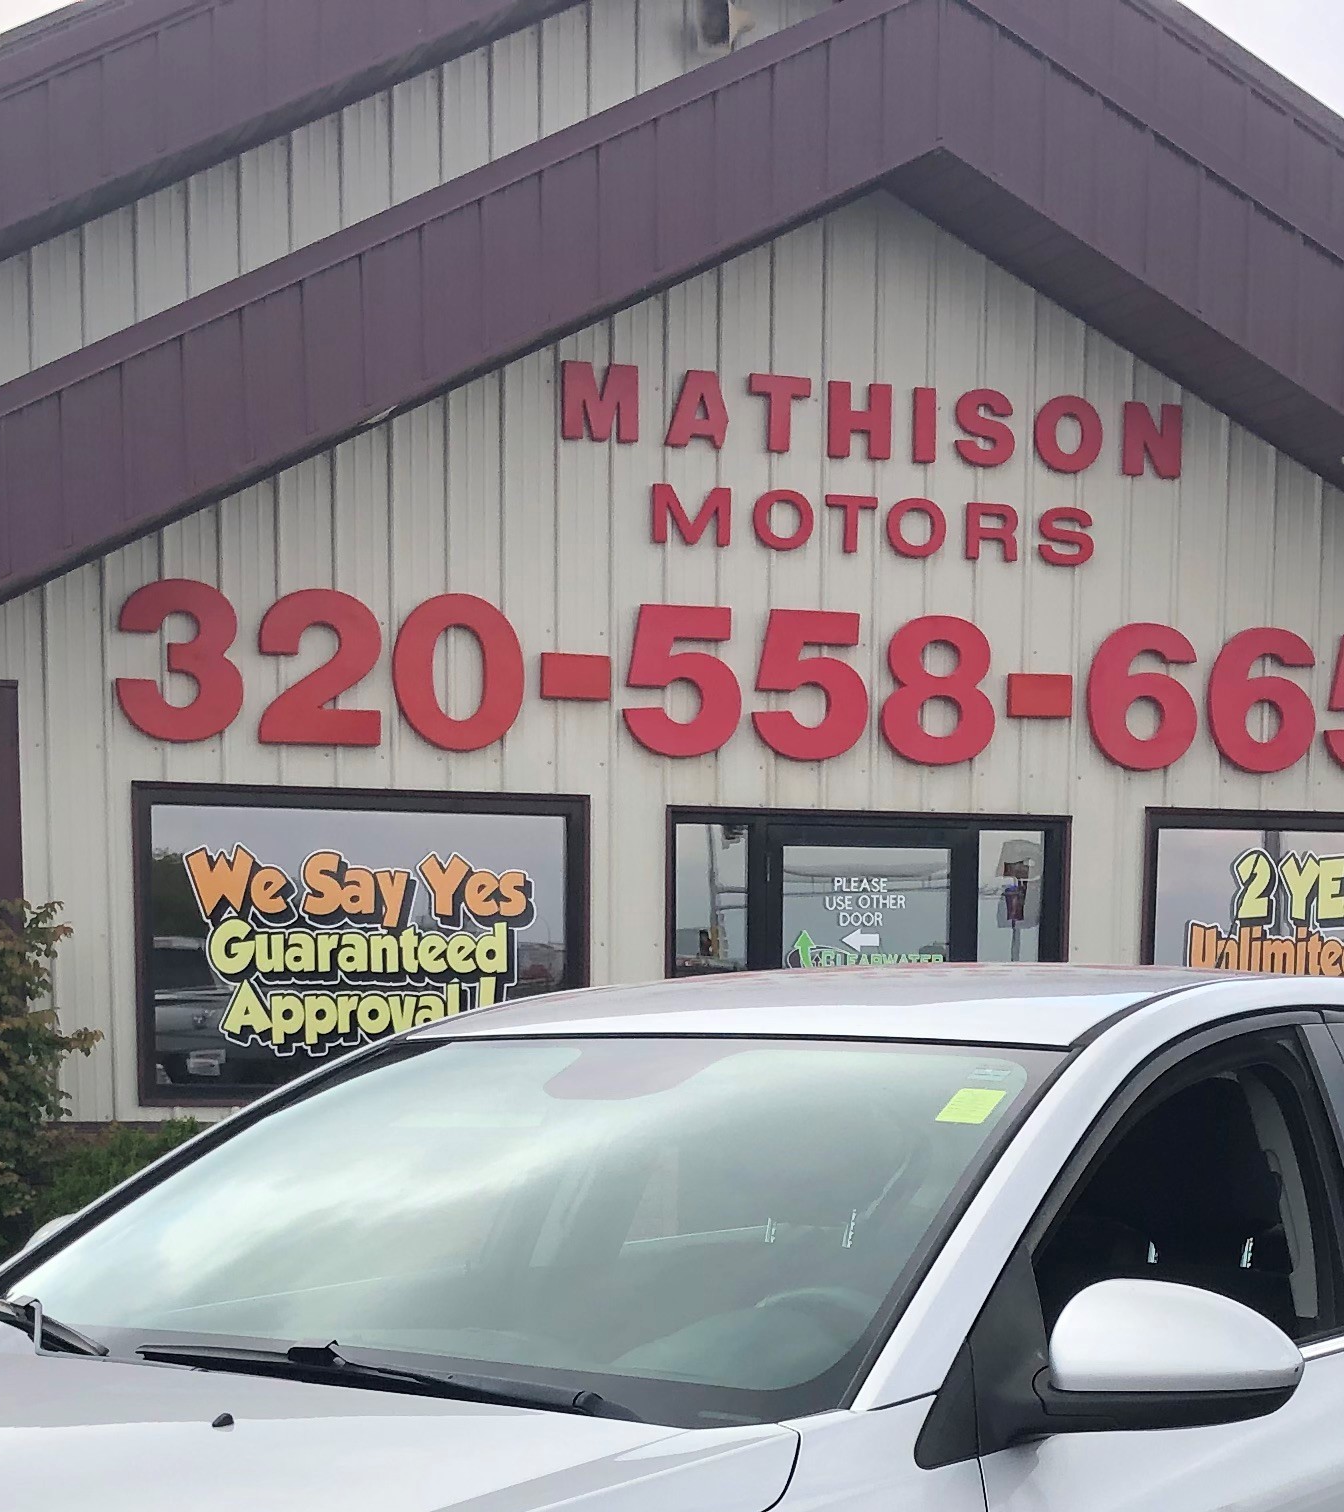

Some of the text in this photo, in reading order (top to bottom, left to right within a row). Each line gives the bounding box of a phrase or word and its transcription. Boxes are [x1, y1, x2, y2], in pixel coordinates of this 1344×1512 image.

[561, 359, 1183, 480] MATHISON
[651, 483, 1095, 568] MOTORS
[185, 844, 529, 927] We Say Yes
[825, 894, 906, 911] USE OTHER
[834, 876, 888, 893] PLEASE
[1236, 852, 1272, 920] 2
[209, 921, 509, 975] Guaranteed
[839, 911, 883, 927] DOOR
